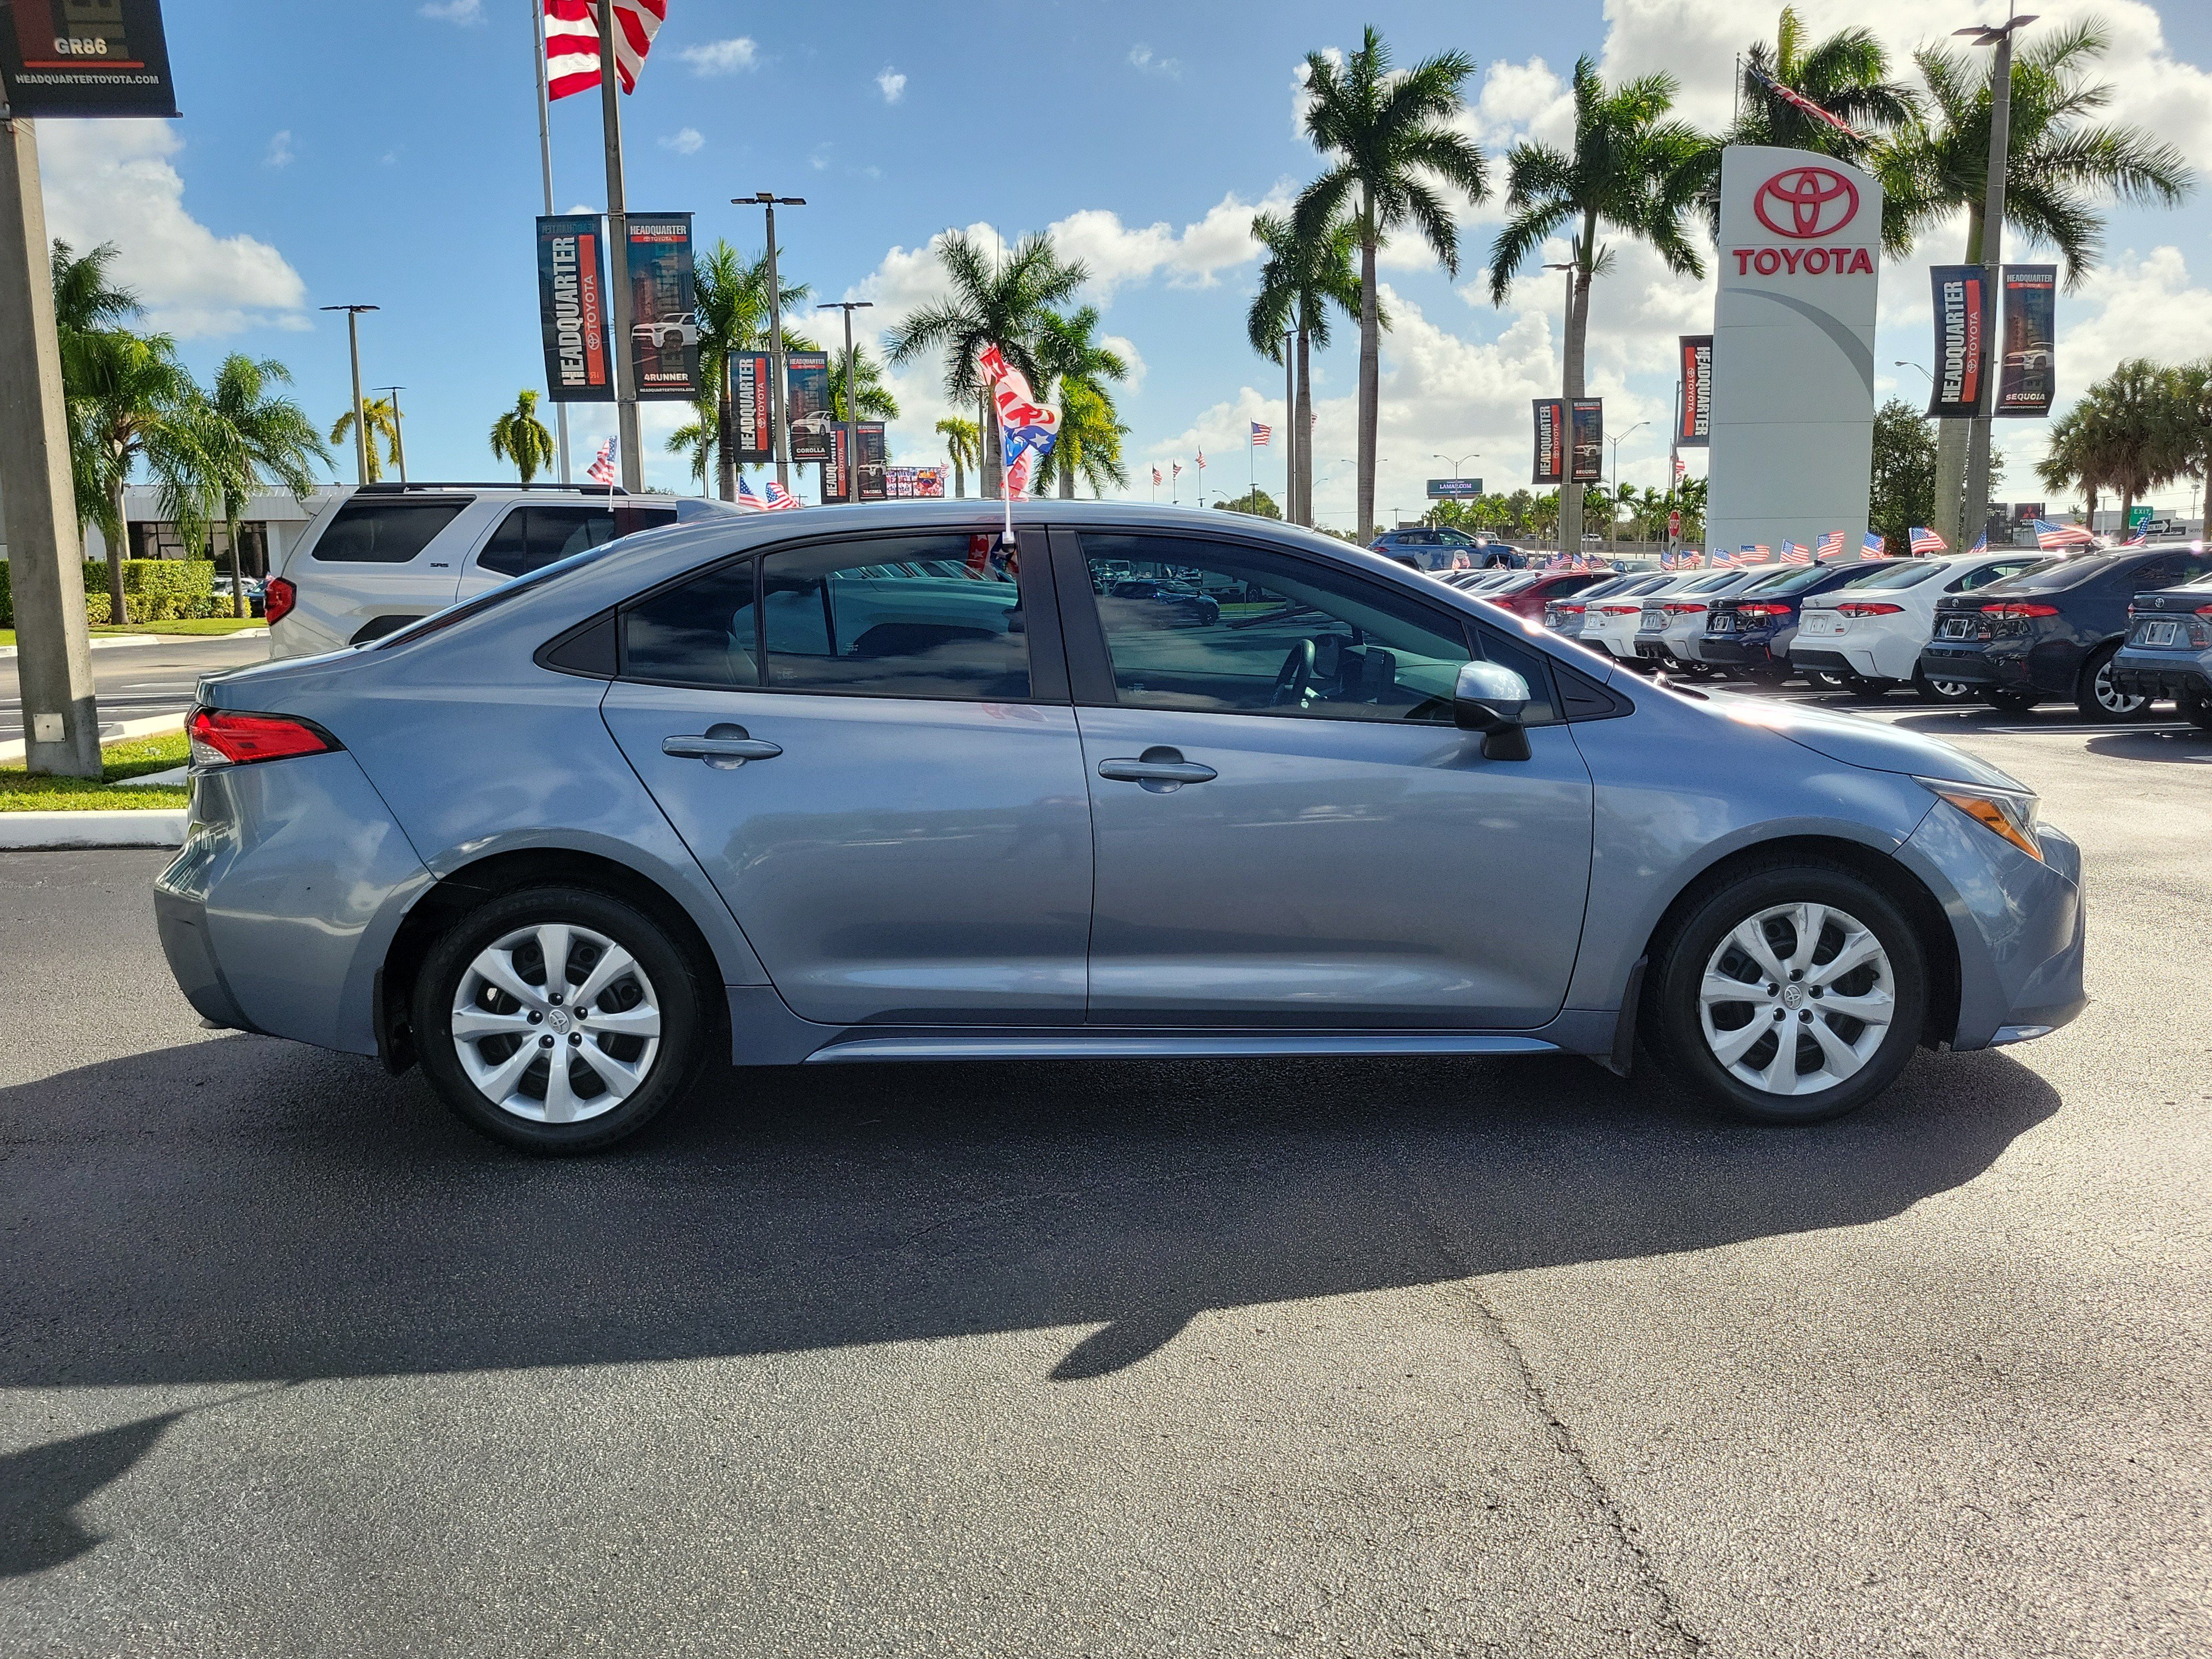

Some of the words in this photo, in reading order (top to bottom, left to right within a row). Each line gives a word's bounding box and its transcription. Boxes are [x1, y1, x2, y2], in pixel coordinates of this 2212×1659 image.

[54, 38, 108, 54] GR86
[15, 75, 159, 85] HEADQUARTERTOYOTA.COM
[630, 225, 687, 236] HEADQUARTER
[1733, 247, 1874, 275] TOYOTA
[2007, 274, 2052, 283] HEADQUARTER
[552, 236, 586, 386] HEADQUARTER
[584, 274, 597, 331] TOYOTA
[1941, 281, 1966, 403] HEADQUARTER
[739, 358, 756, 450] HEADQUARTER
[1695, 347, 1711, 436] HEADQUARTER
[1539, 405, 1553, 475] HEADQUARTER
[1670, 519, 1679, 529] STOP
